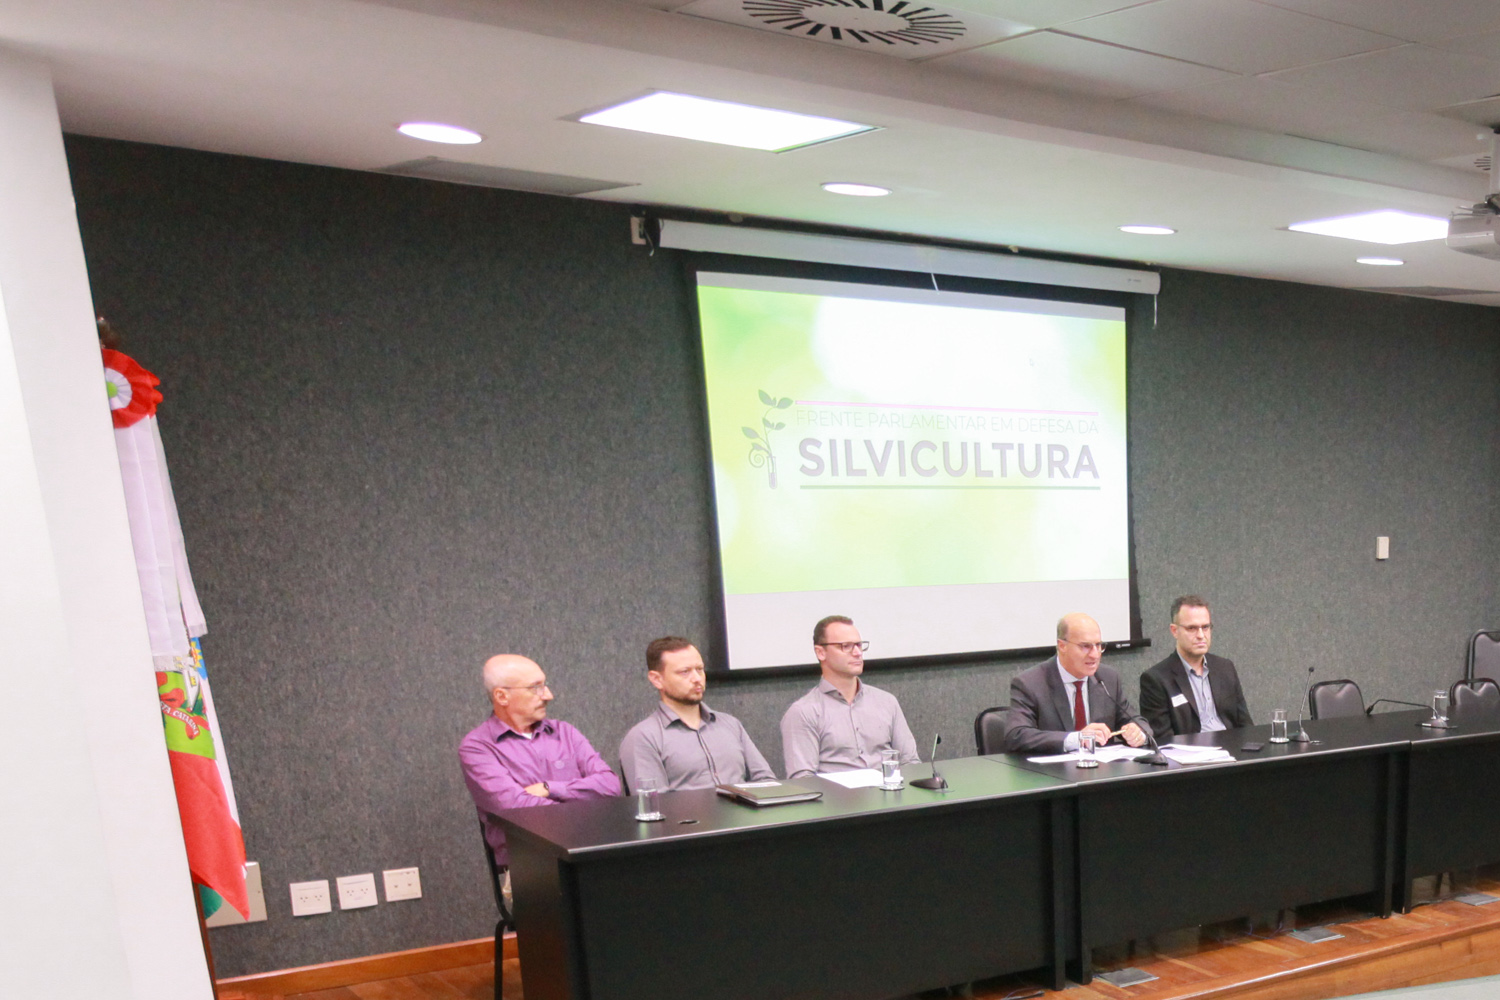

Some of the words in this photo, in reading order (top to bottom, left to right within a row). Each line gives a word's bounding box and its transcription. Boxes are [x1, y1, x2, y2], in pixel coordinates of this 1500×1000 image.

[796, 410, 864, 427] FRENTE
[868, 412, 987, 431] PARLAMENTAR
[991, 416, 1013, 432] EM
[1018, 417, 1075, 434] DEFESA
[1078, 420, 1099, 435] DA
[799, 437, 1100, 479] SILVICULTURA
[172, 710, 200, 735] CATARINA
